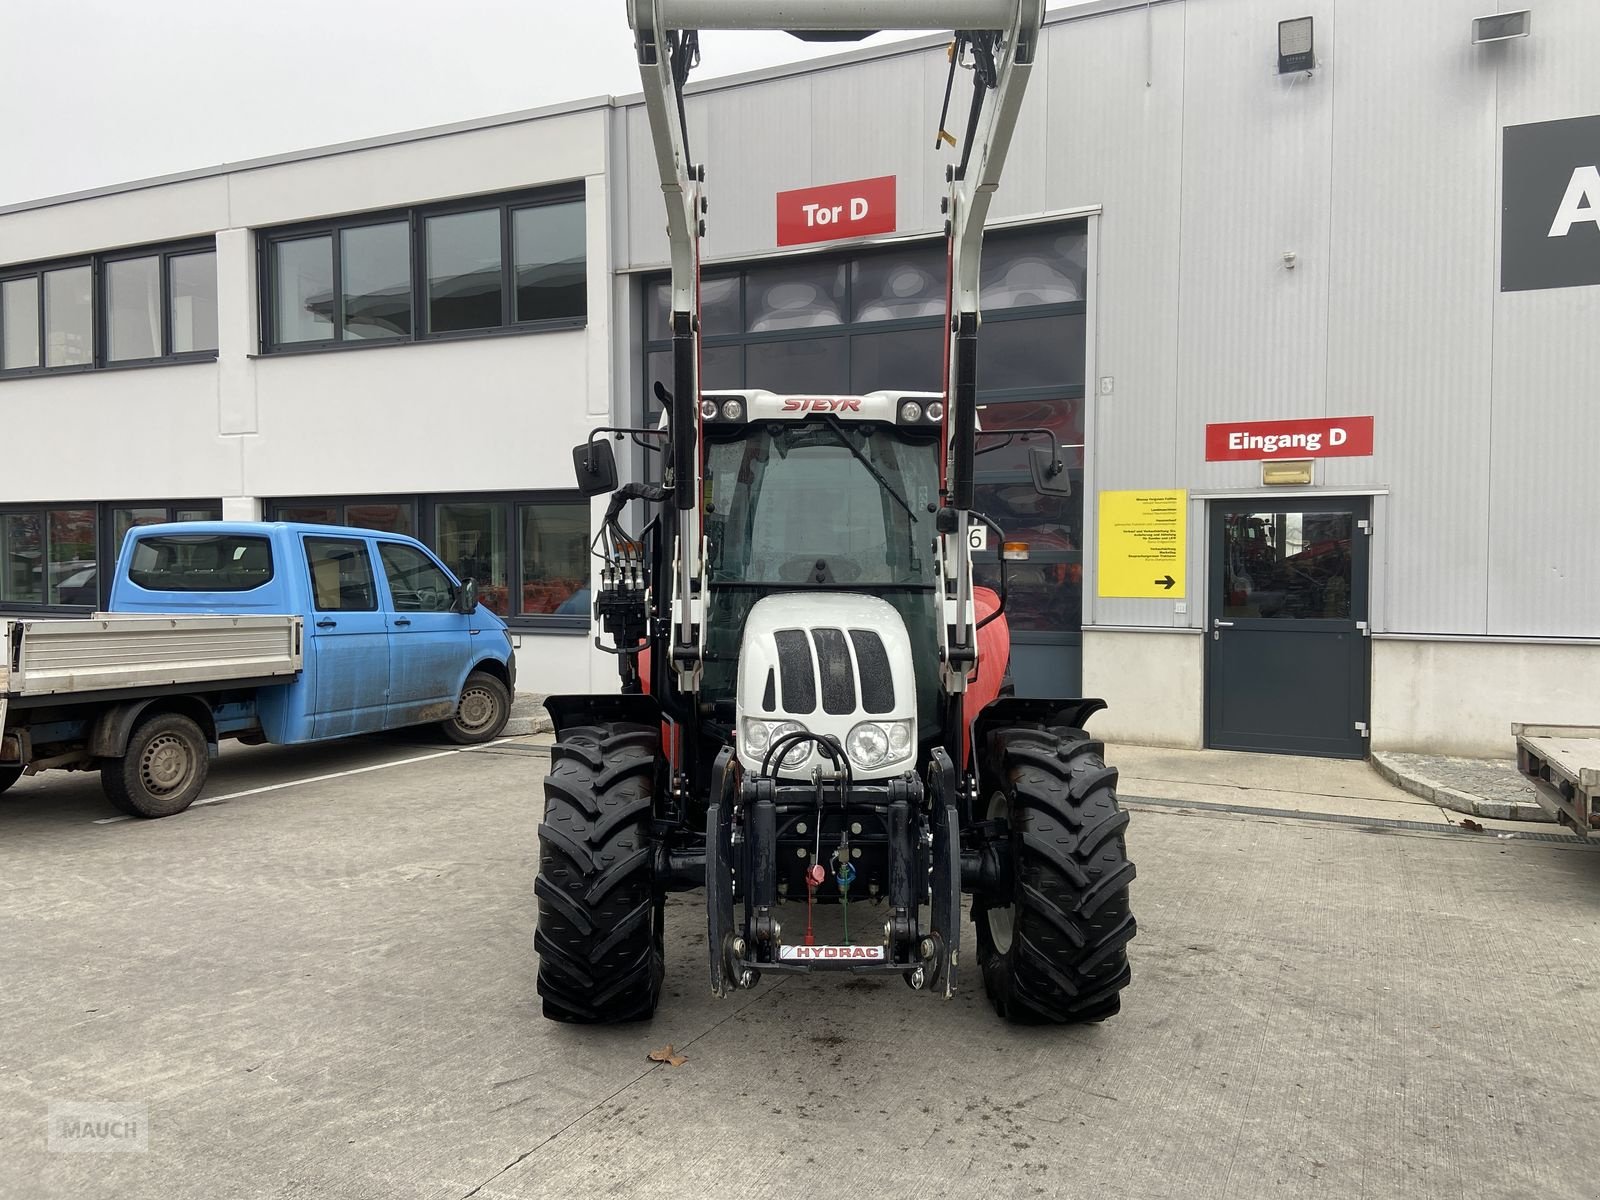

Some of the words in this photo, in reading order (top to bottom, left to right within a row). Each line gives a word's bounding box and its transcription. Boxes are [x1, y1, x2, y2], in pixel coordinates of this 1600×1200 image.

[802, 203, 842, 227] Tor
[850, 197, 869, 221] D
[781, 398, 862, 412] STEYR
[1228, 432, 1322, 453] Eingang
[1329, 427, 1347, 446] D
[969, 528, 982, 549] 6
[796, 947, 879, 958] HYDRAC
